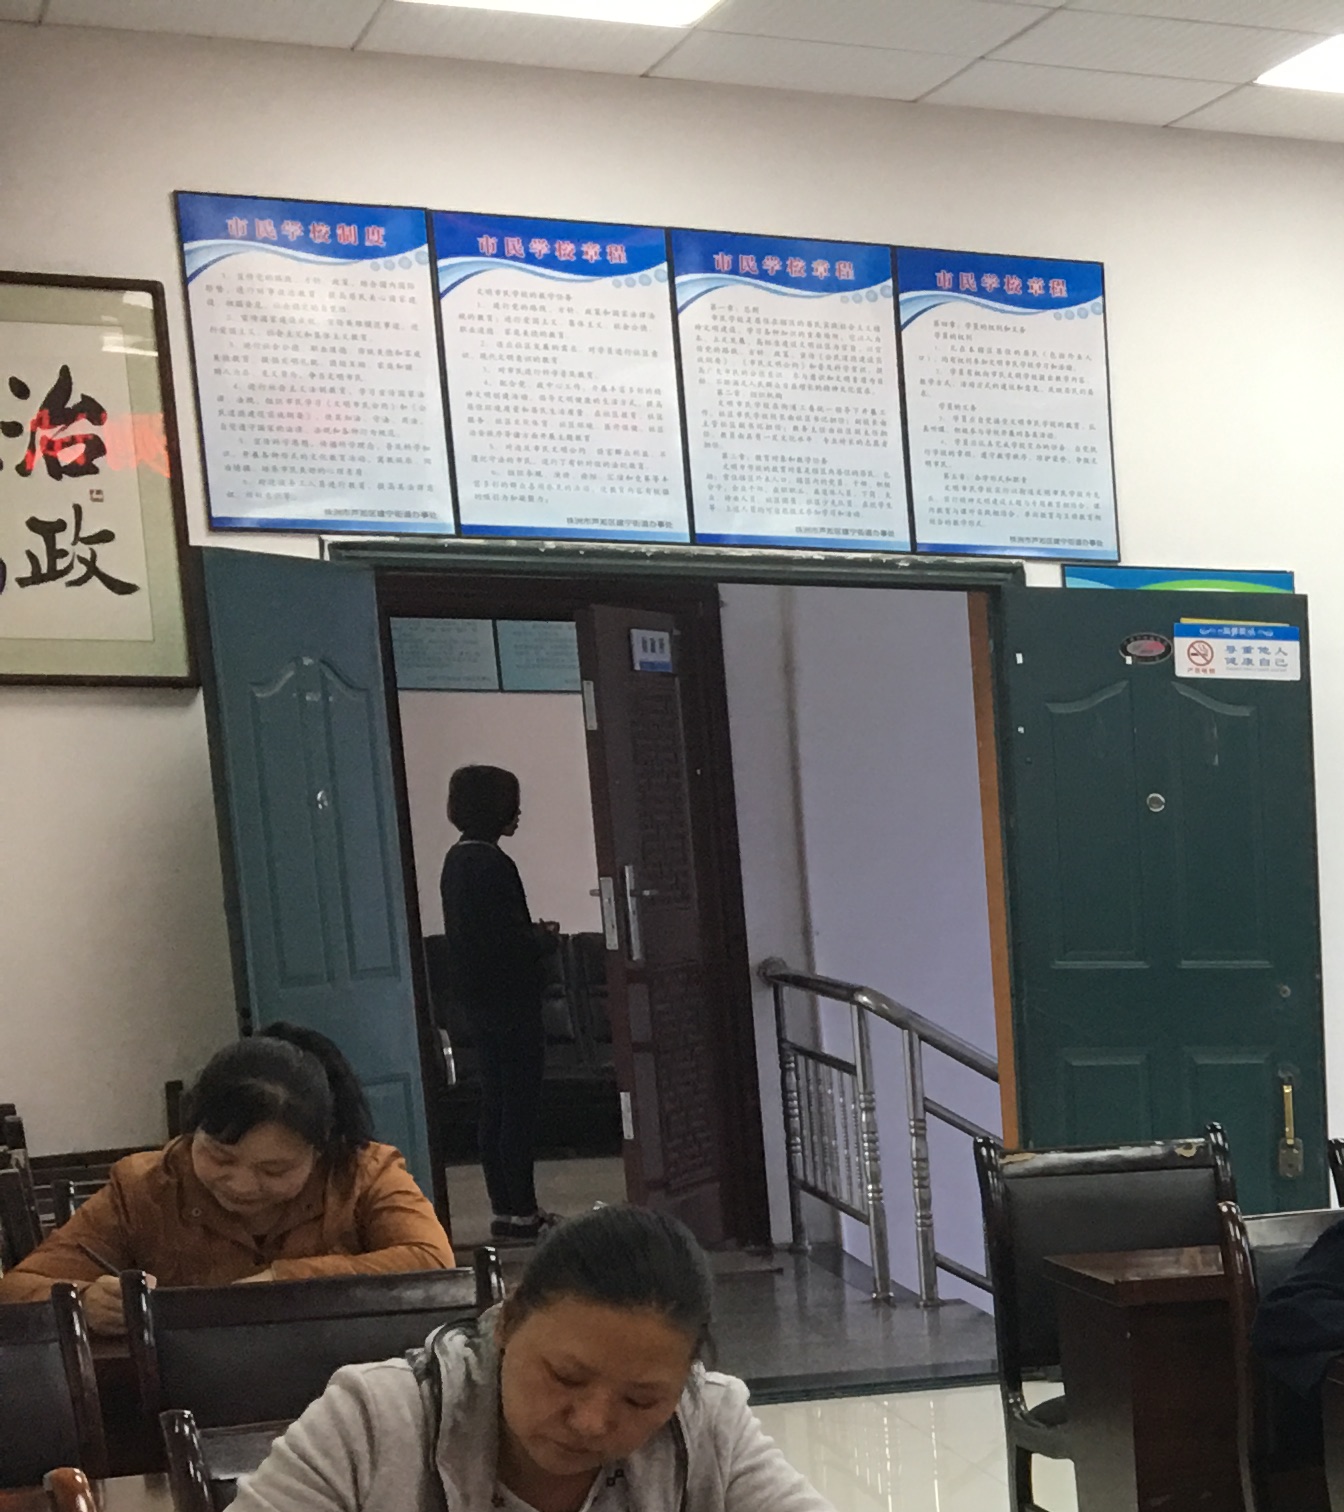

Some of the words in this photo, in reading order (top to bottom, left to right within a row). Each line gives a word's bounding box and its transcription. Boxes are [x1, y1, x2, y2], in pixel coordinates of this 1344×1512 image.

[226, 216, 387, 247] 市民学校制度
[477, 234, 628, 265] 市民学校章程
[713, 252, 856, 281] 市民学校章程
[935, 269, 1069, 298] 市民学校章程
[1226, 645, 1288, 656] 尊重他人
